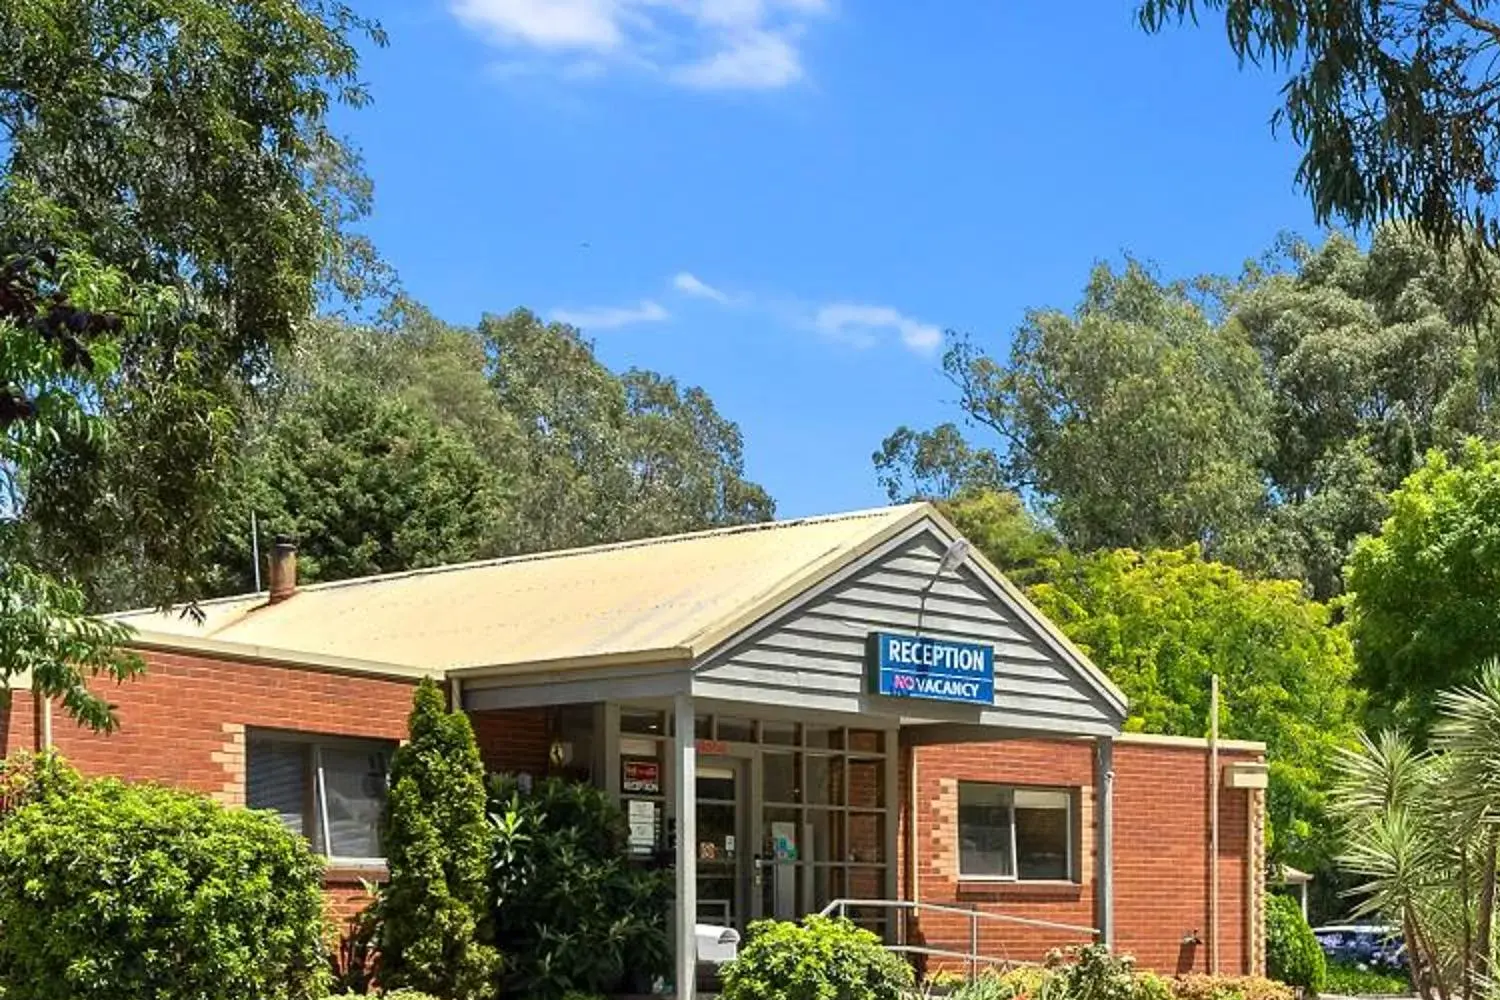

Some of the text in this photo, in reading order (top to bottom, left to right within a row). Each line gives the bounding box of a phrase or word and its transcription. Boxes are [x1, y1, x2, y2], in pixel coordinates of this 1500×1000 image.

[889, 640, 984, 671] RECEPTION
[894, 674, 979, 697] NO VACANCY
